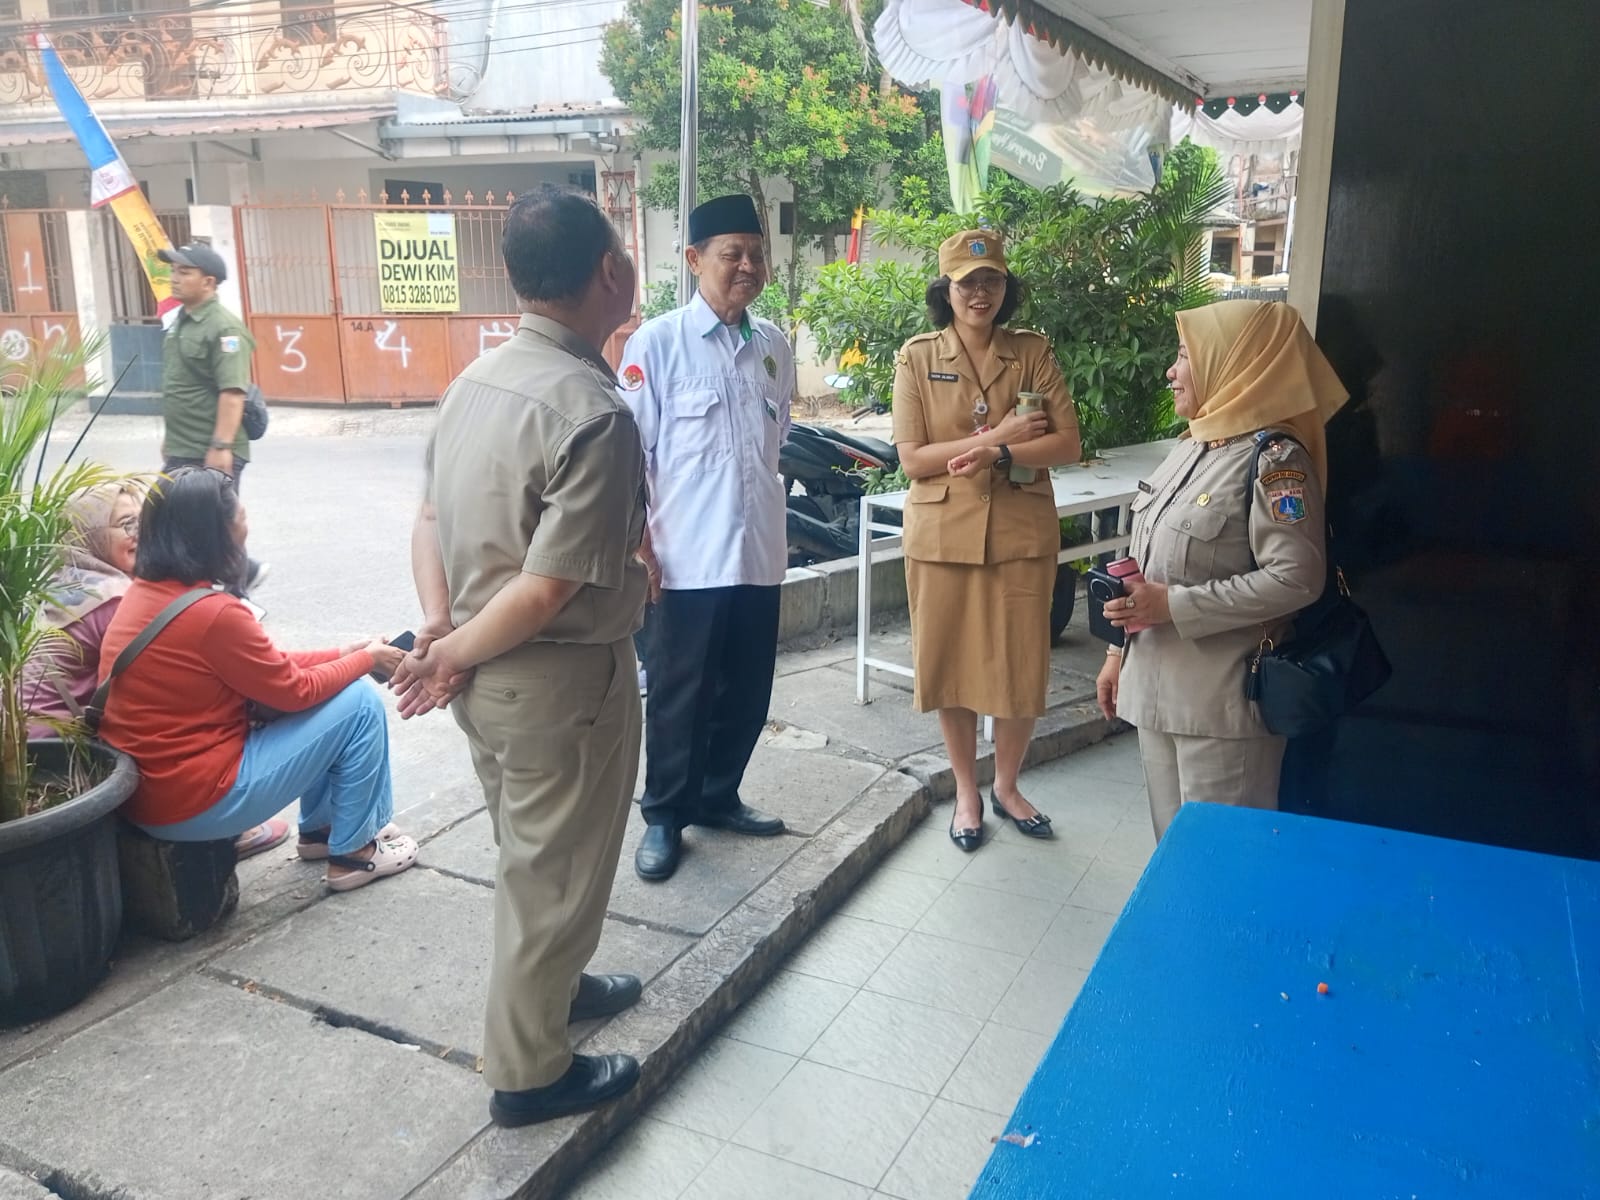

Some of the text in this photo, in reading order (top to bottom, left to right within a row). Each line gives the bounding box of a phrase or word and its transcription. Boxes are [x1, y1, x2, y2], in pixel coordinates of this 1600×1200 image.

[381, 239, 455, 260] DIJUAL
[18, 250, 43, 294] 1
[382, 264, 455, 281] DEWI KIM
[383, 285, 457, 304] 0815 3285 0125
[276, 324, 307, 372] 3
